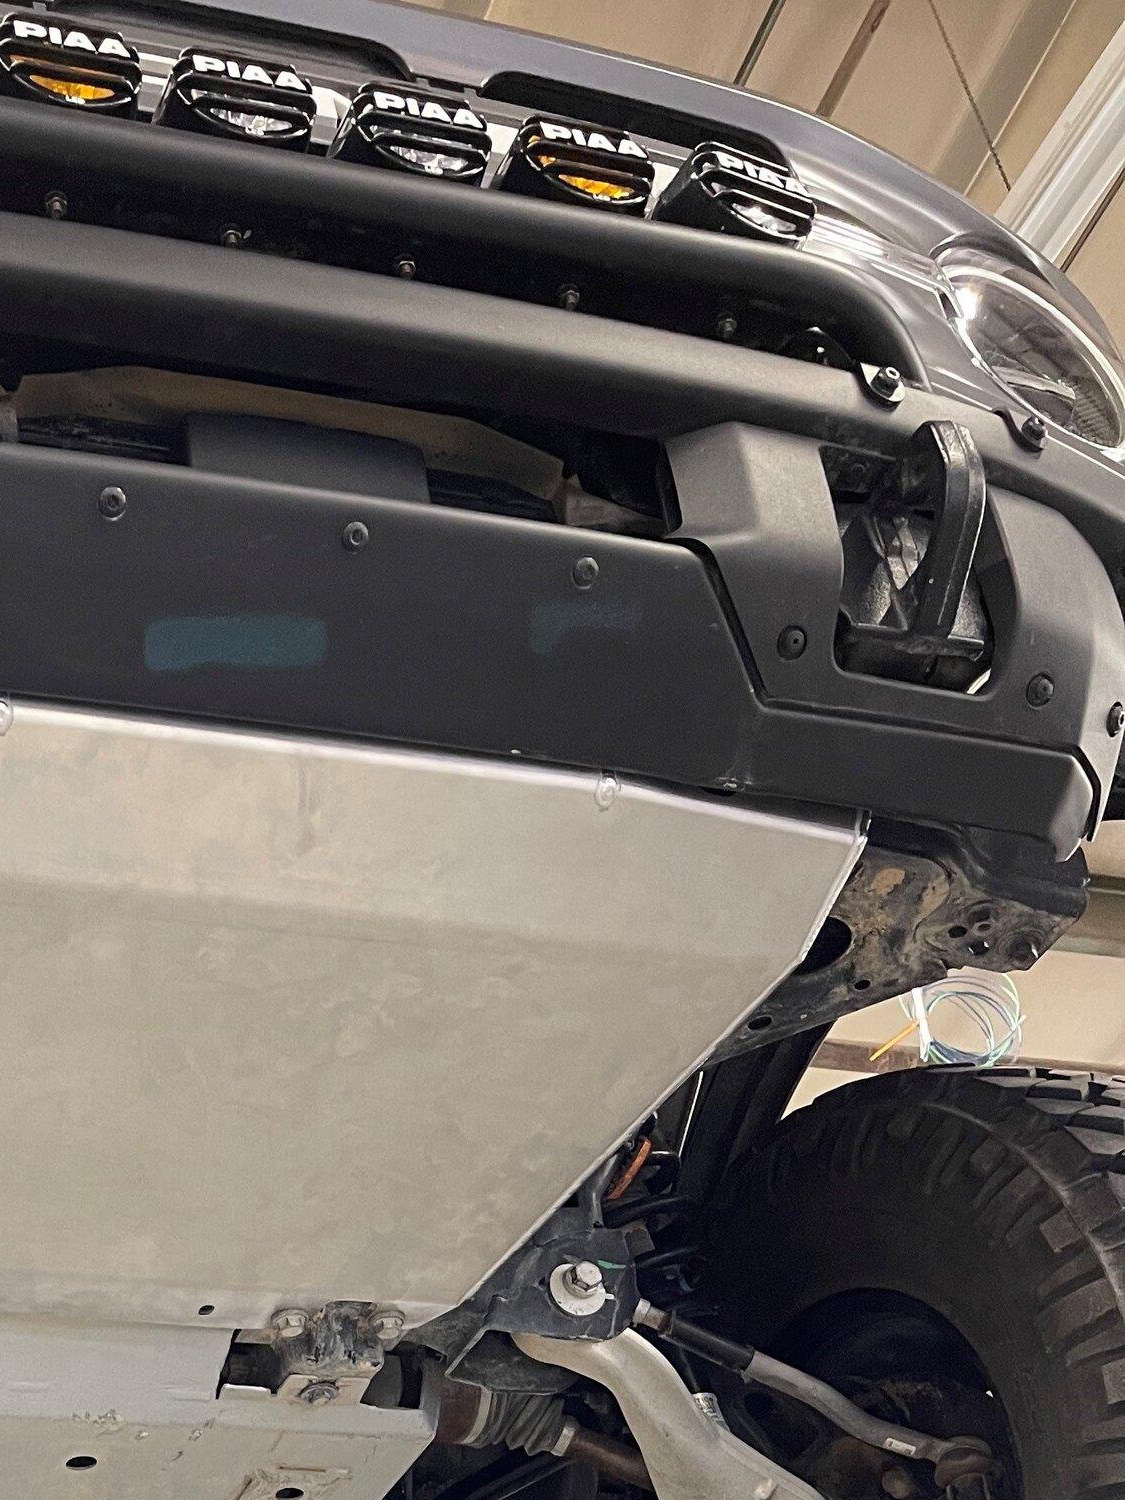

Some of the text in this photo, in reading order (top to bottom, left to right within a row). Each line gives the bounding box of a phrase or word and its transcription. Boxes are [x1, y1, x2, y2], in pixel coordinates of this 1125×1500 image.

[13, 20, 131, 58] PIAA
[192, 54, 307, 91] PIAA
[373, 91, 484, 129] PIAA
[540, 121, 648, 158] PIAA
[715, 151, 811, 197] PIAA
